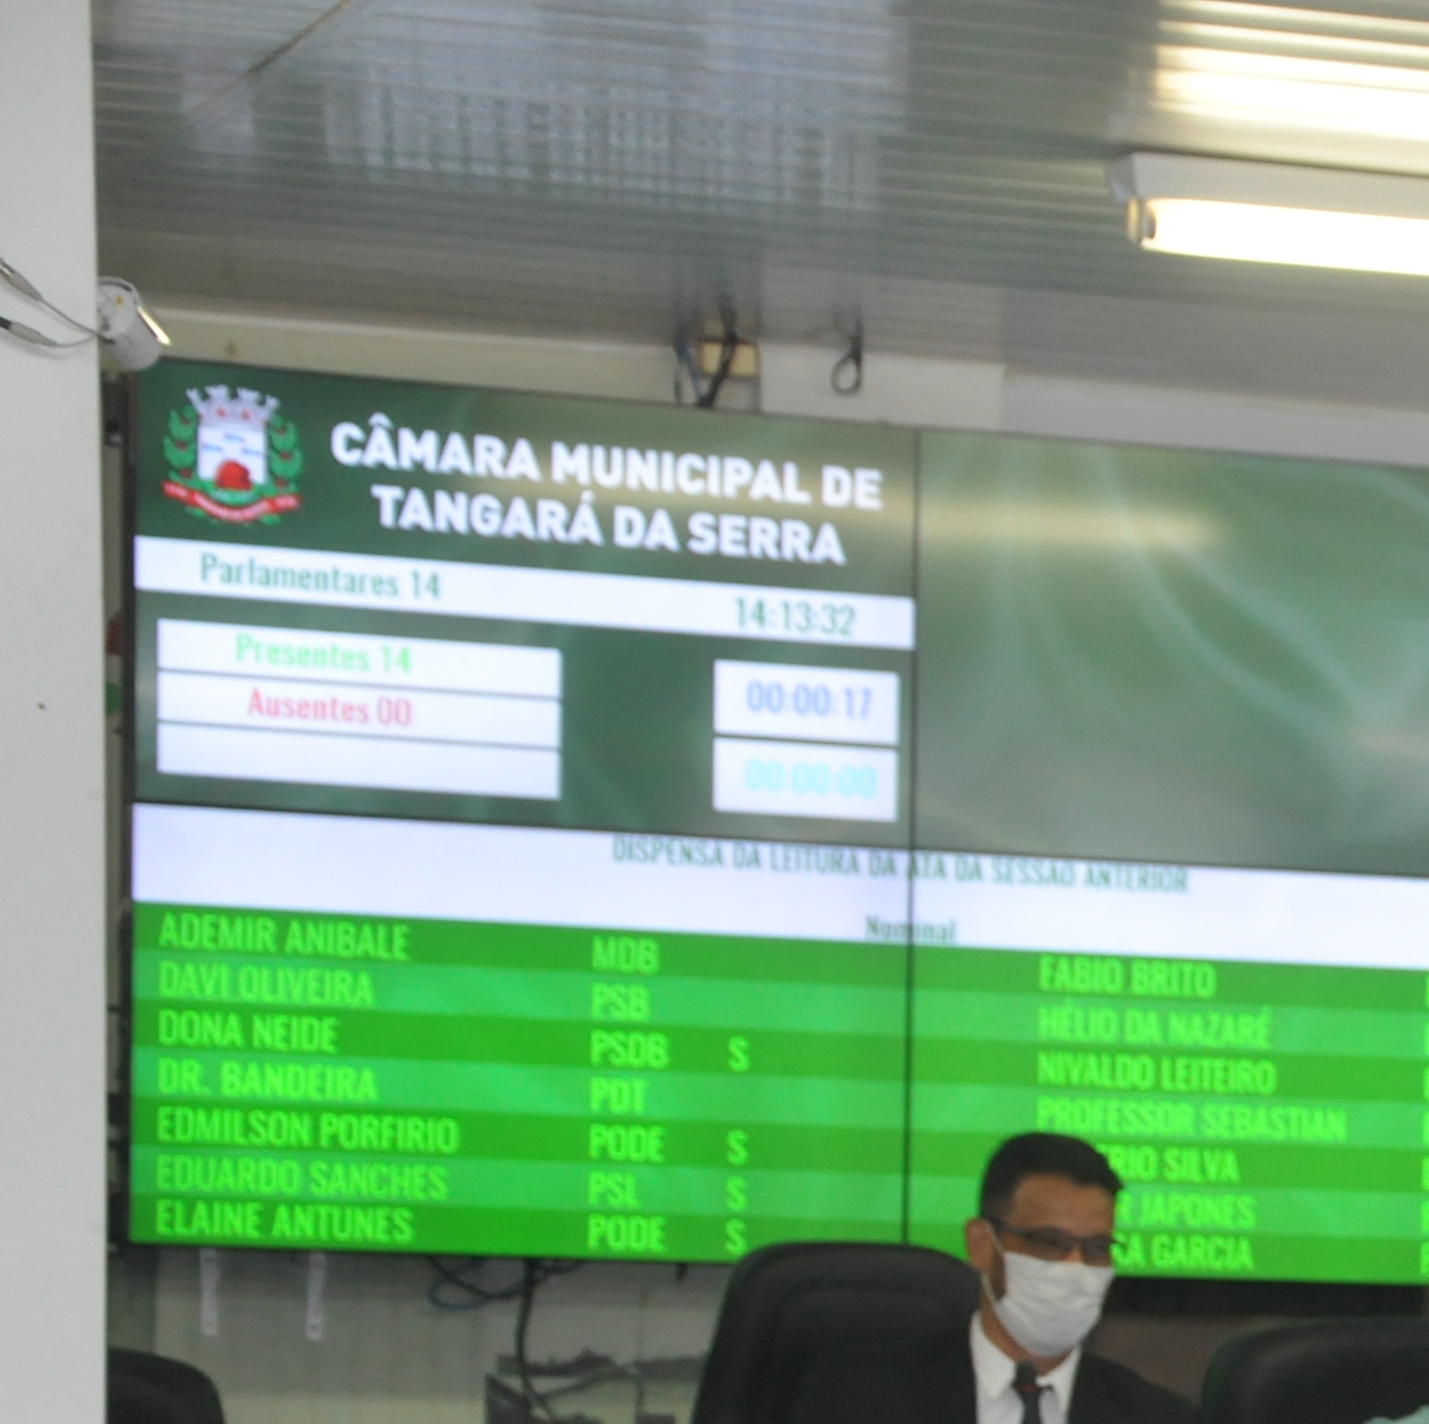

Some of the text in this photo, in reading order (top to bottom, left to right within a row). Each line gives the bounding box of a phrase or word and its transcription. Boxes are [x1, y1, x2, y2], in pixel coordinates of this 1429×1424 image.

[331, 413, 882, 509] CÂMARA MUNICIPAL DE
[372, 486, 847, 565] TANGARÁ DA SERRA
[200, 553, 441, 601] Parlamentares 14
[735, 597, 856, 637] 14:13:32
[235, 634, 412, 674] Presentes 14
[247, 688, 412, 728] Ausentes 00
[746, 679, 872, 721] 00:00:17
[612, 835, 722, 869] DISPENSA
[733, 845, 761, 870] DA
[770, 847, 861, 877] LEITURA
[868, 852, 898, 878] DA
[954, 856, 984, 883] DA
[1083, 862, 1191, 894] ANTERIOR
[159, 912, 660, 975] ADEMIR ANIBALE MDB
[158, 961, 650, 1022] DAVI OLIVEIRA PSB
[1131, 959, 1216, 1000] BRITO
[157, 1009, 750, 1073] DONA NEIDE PSDB S
[1037, 999, 1120, 1044] HÉLIO
[1124, 1009, 1161, 1045] DA
[1167, 1005, 1273, 1050] NAZARÉ
[220, 1060, 378, 1103] BANDEIRA
[1037, 1051, 1150, 1093] NIVALDO
[1161, 1056, 1277, 1097] LEITEIRO
[157, 1106, 311, 1149] EDMILSON
[588, 1125, 666, 1163] PODE
[727, 1130, 749, 1167] S
[1037, 1096, 1195, 1139] PROFESSOR
[1203, 1102, 1347, 1143] SEBASTIAN
[156, 1154, 748, 1212] EDUARDO SANCHES PSL S
[1163, 1147, 1241, 1183] SILVA
[155, 1200, 747, 1255] ELAINE ANTUNES PODE S
[1150, 1236, 1254, 1271] GARCIA
